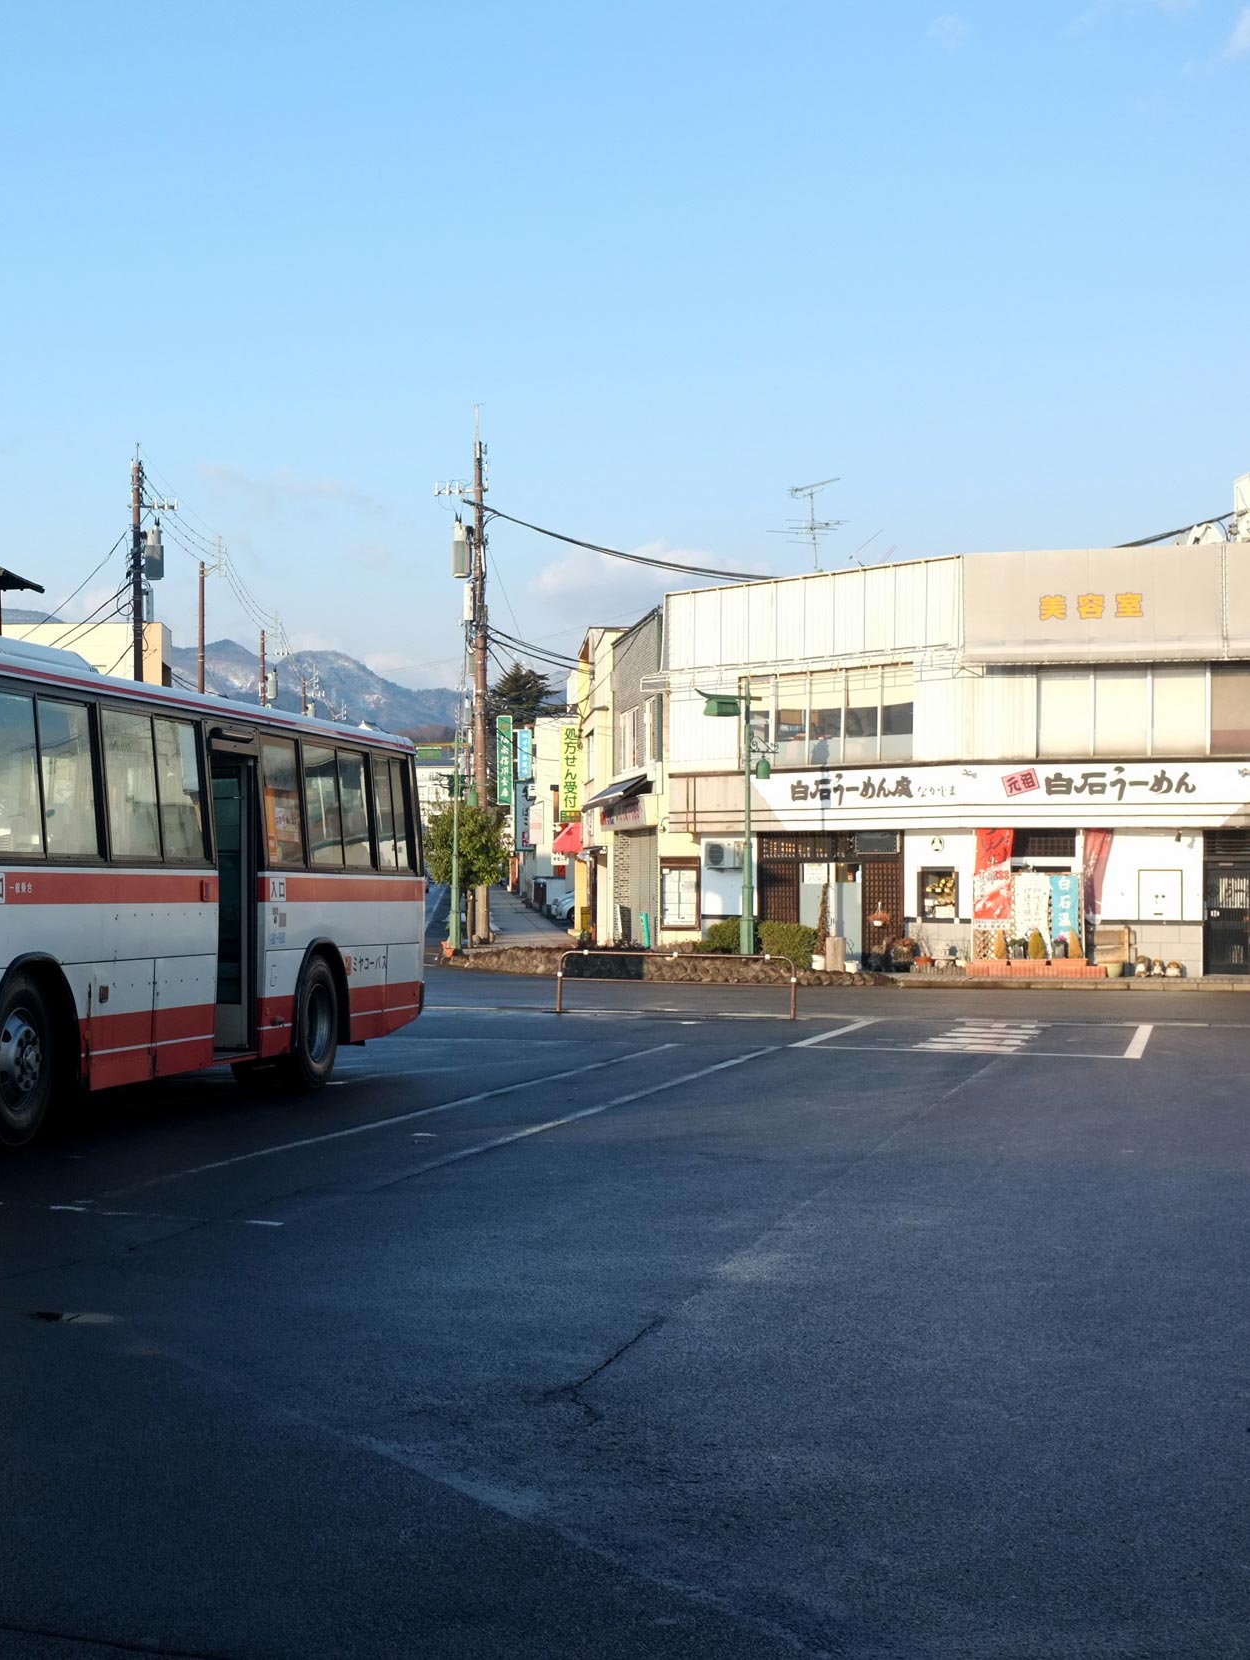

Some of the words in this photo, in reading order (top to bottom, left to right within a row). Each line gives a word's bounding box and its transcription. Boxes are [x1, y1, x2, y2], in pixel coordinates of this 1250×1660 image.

[1039, 592, 1143, 621] 美容室
[564, 727, 578, 808] 処方せん受付
[1007, 772, 1037, 794] 元祖
[1044, 766, 1196, 801] 白石うーめん
[270, 881, 285, 899] 入口
[353, 955, 387, 973] ミヤコーバス
